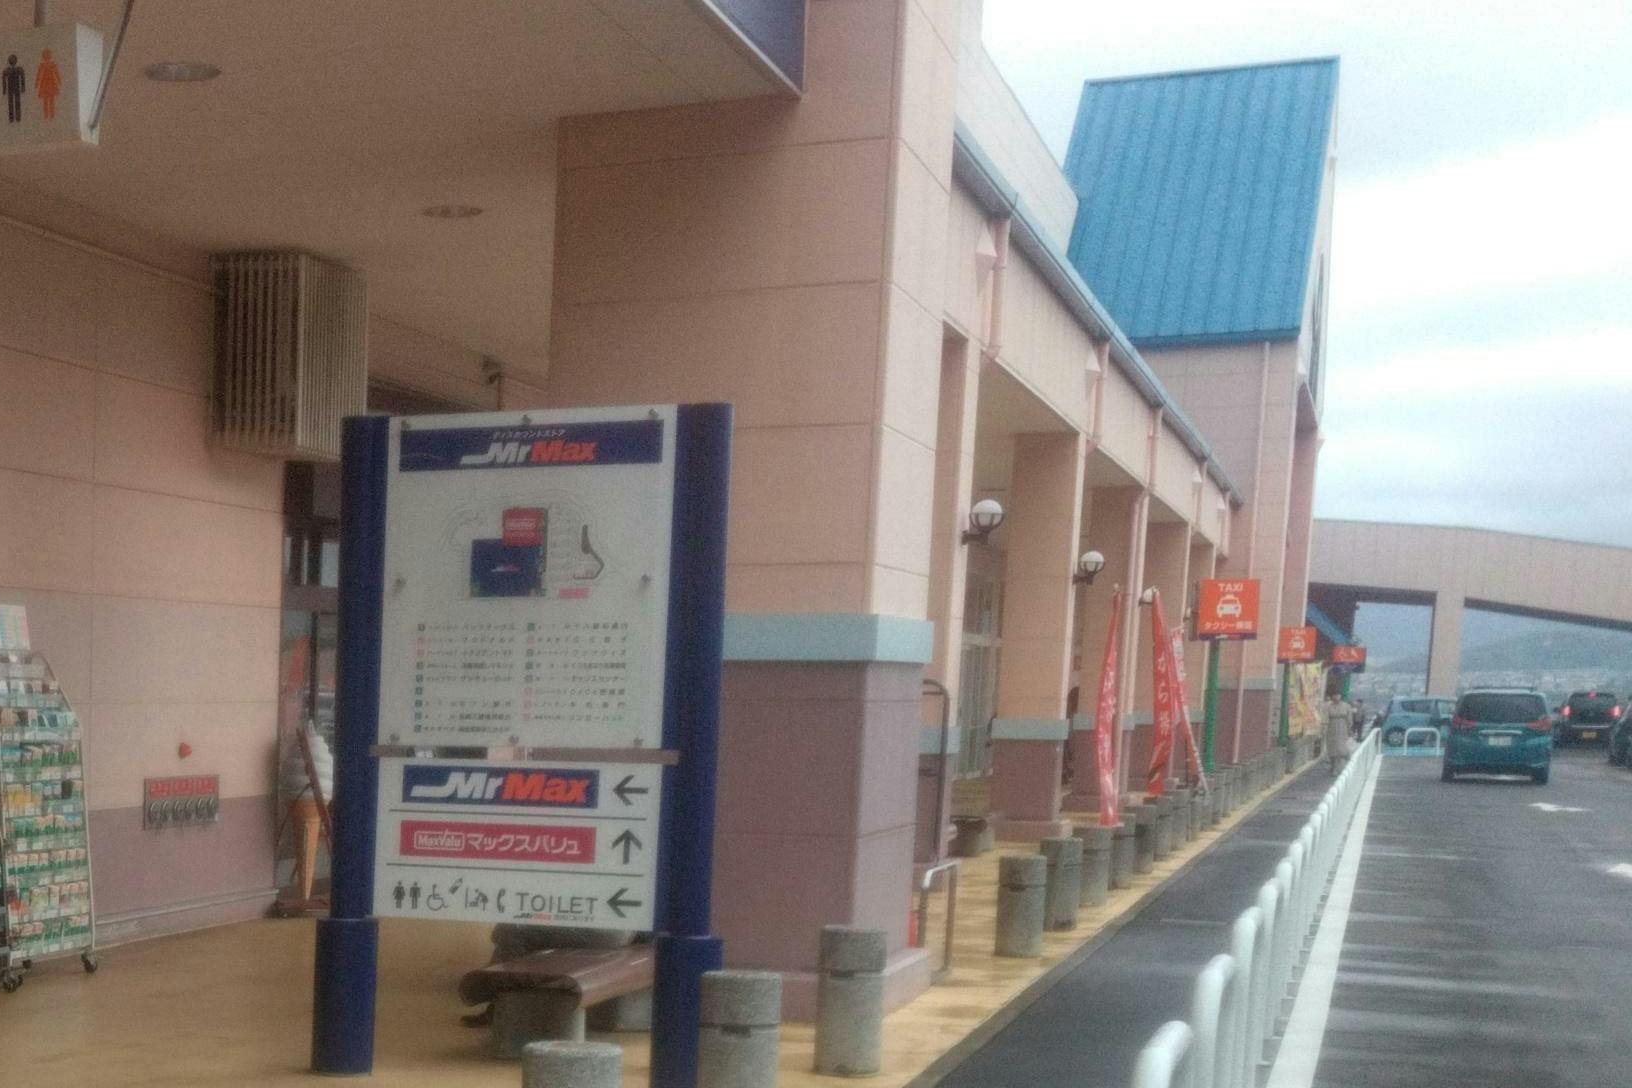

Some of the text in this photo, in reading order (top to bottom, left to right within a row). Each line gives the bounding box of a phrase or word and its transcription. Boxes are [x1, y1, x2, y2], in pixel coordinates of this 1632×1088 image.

[460, 440, 597, 465] MrMax
[1218, 583, 1244, 593] TAXI
[410, 771, 591, 804] MrMax
[417, 829, 581, 856] MaxValu マックスバリュ
[516, 891, 598, 915] TOILET
